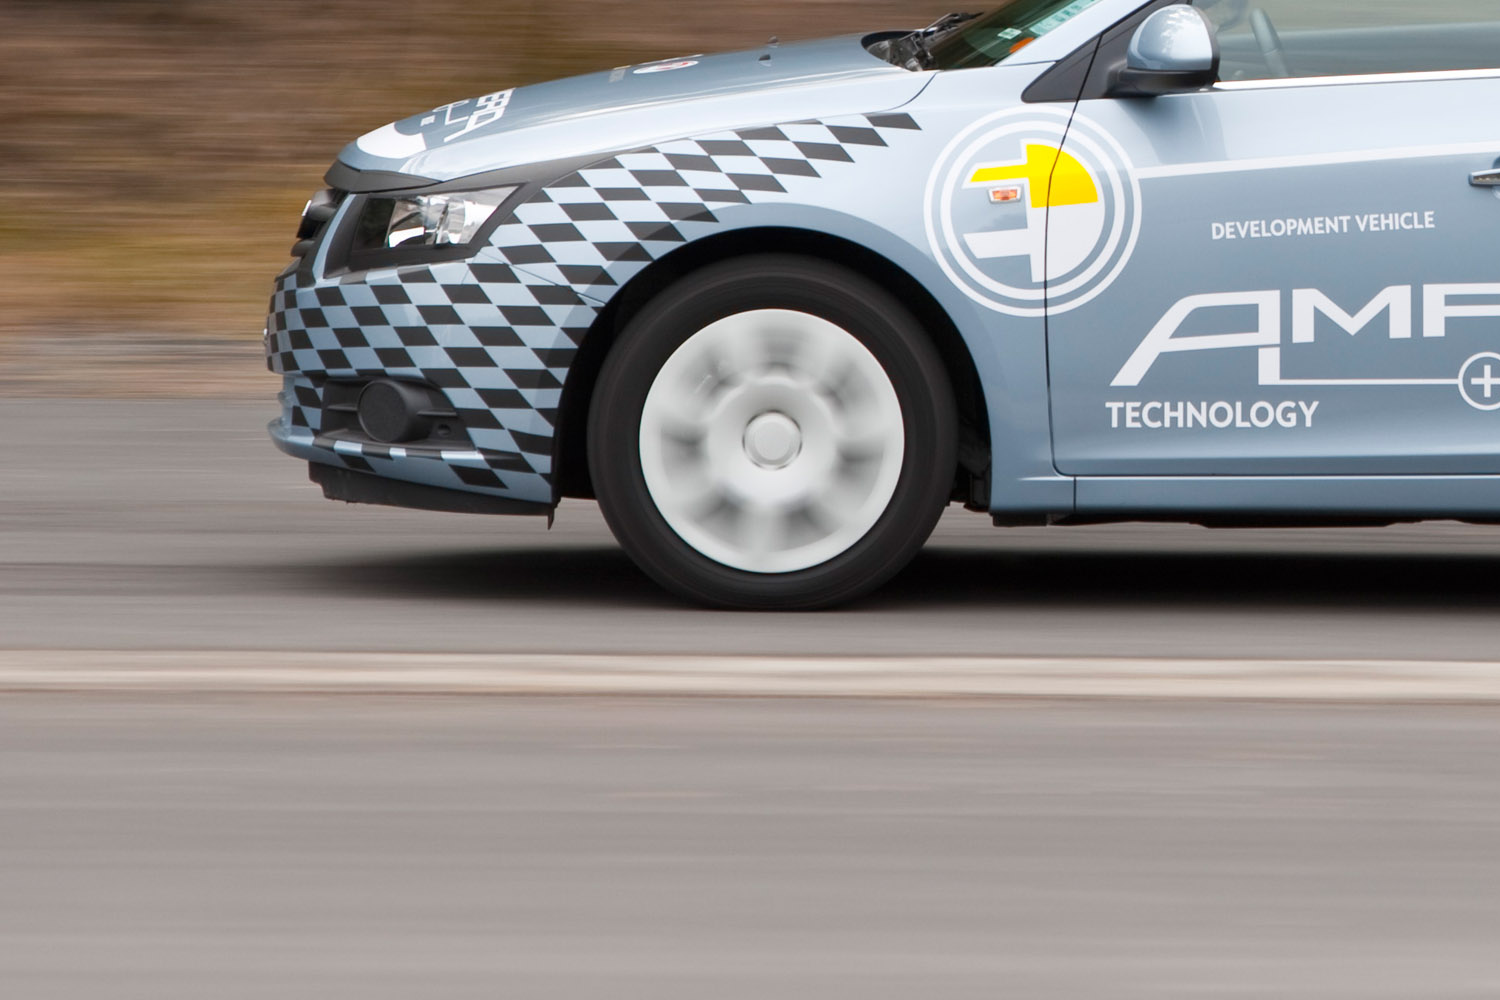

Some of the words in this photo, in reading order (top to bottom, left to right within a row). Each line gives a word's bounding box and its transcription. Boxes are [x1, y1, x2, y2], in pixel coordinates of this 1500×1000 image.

[443, 87, 516, 143] ERA
[1211, 215, 1351, 240] DEVELOPMENT
[1354, 210, 1436, 232] VEHICLE
[1105, 400, 1320, 429] TECHNOLOGY
